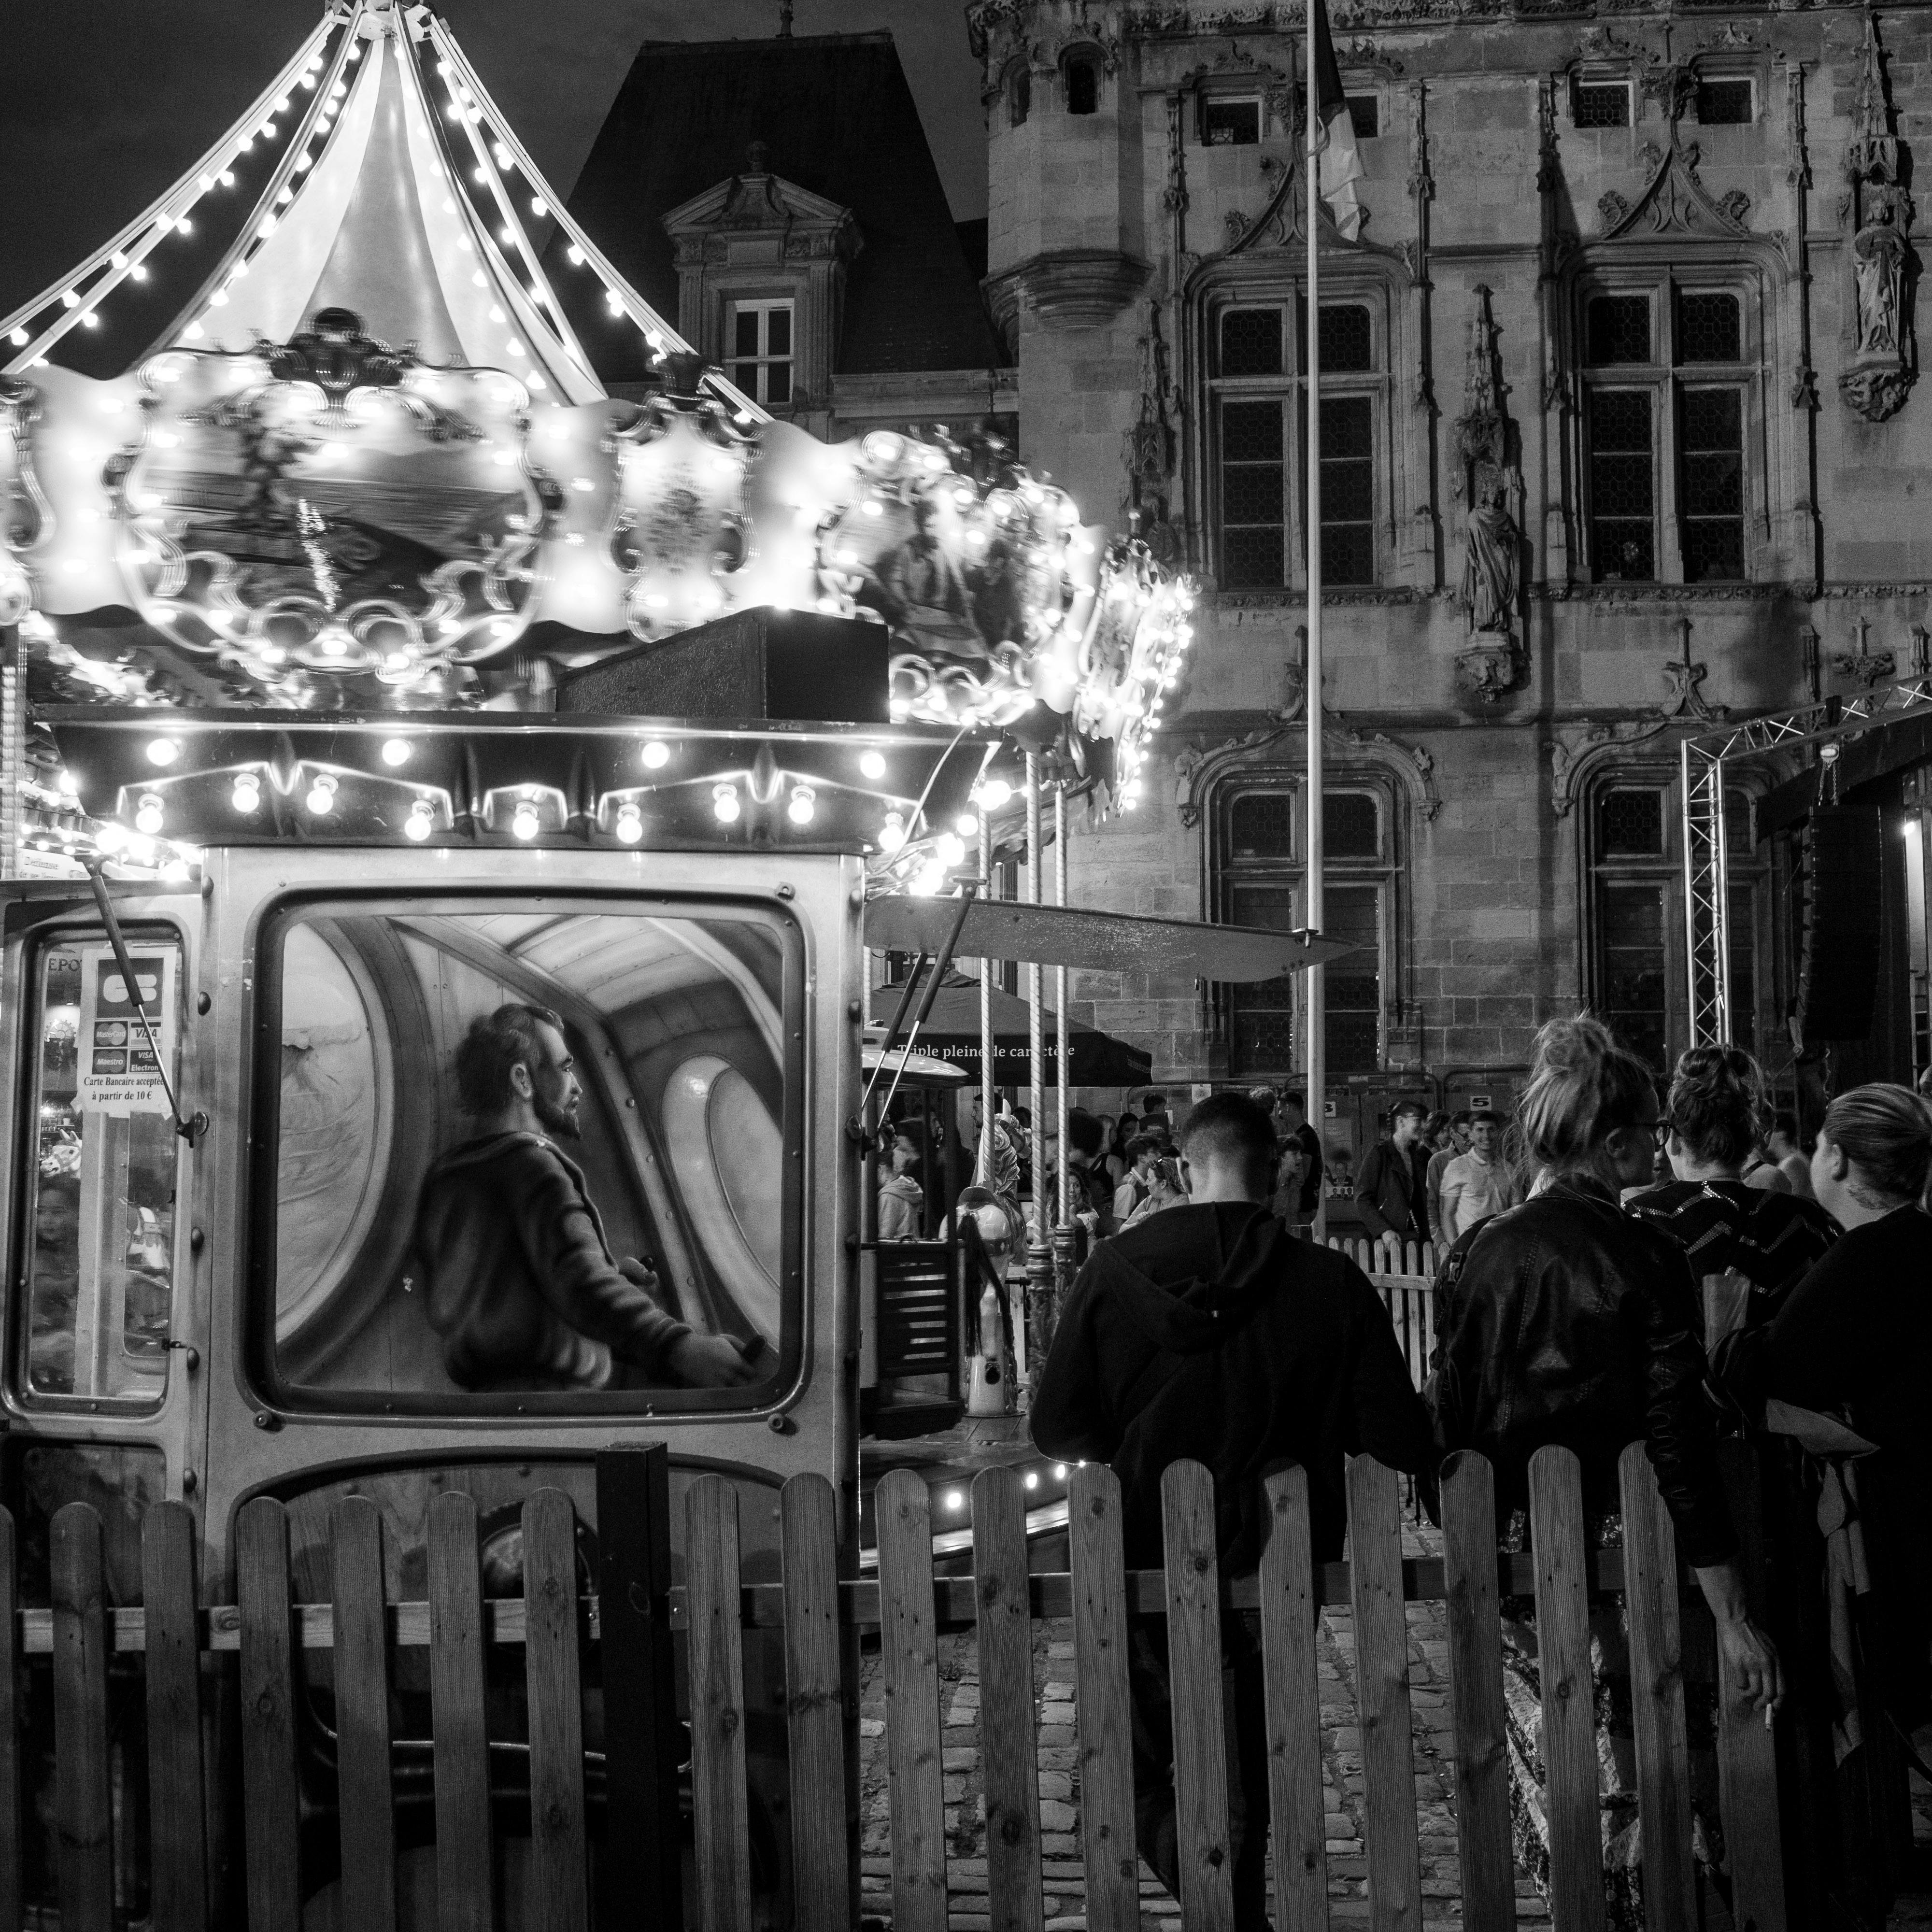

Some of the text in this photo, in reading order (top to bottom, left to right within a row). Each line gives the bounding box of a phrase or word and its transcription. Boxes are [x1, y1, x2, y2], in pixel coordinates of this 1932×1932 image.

[897, 1044, 938, 1057] Tiple
[943, 1045, 983, 1060] pleine
[84, 1076, 164, 1087] Carte Bancaire acceptée
[92, 1091, 153, 1103] à partir de 10 €
[1472, 1097, 1490, 1107] 5
